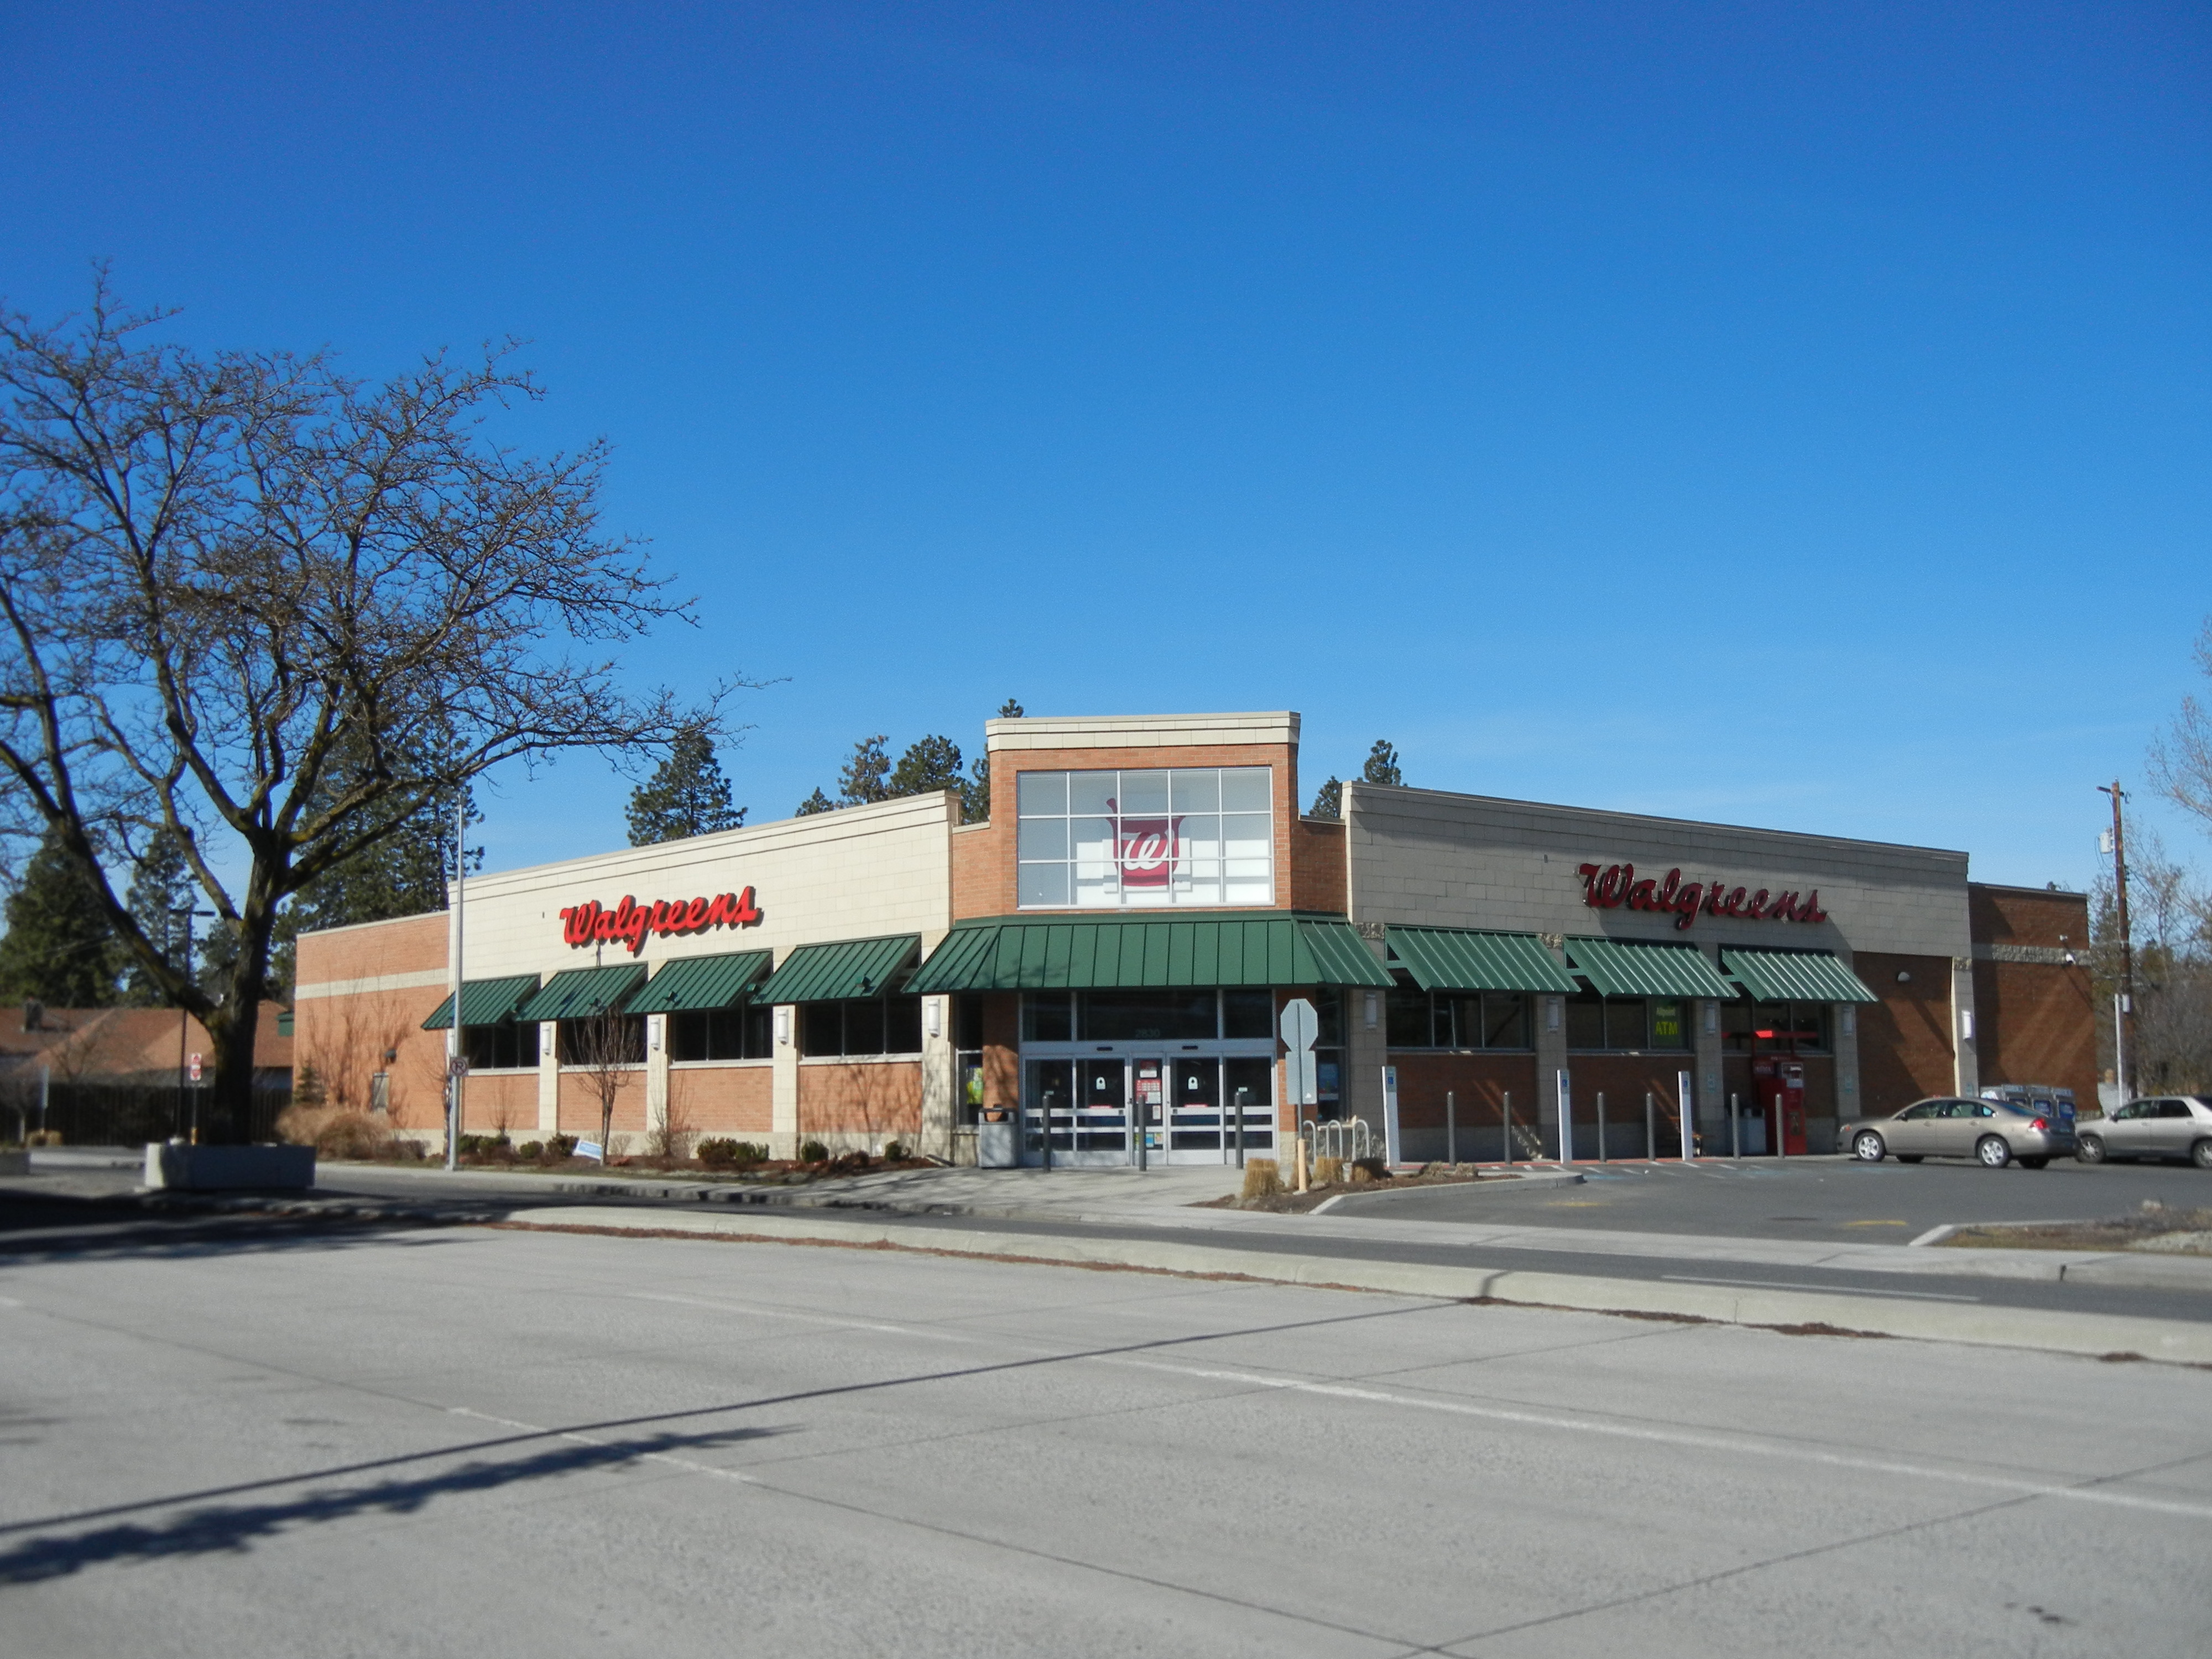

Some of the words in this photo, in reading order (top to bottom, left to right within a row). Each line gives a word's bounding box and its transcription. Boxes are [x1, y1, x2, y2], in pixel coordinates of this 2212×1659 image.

[1578, 863, 1827, 930] Walgreens
[560, 886, 763, 952] Walgreens
[1135, 1028, 1160, 1039] 2830
[1655, 1021, 1678, 1035] ATM
